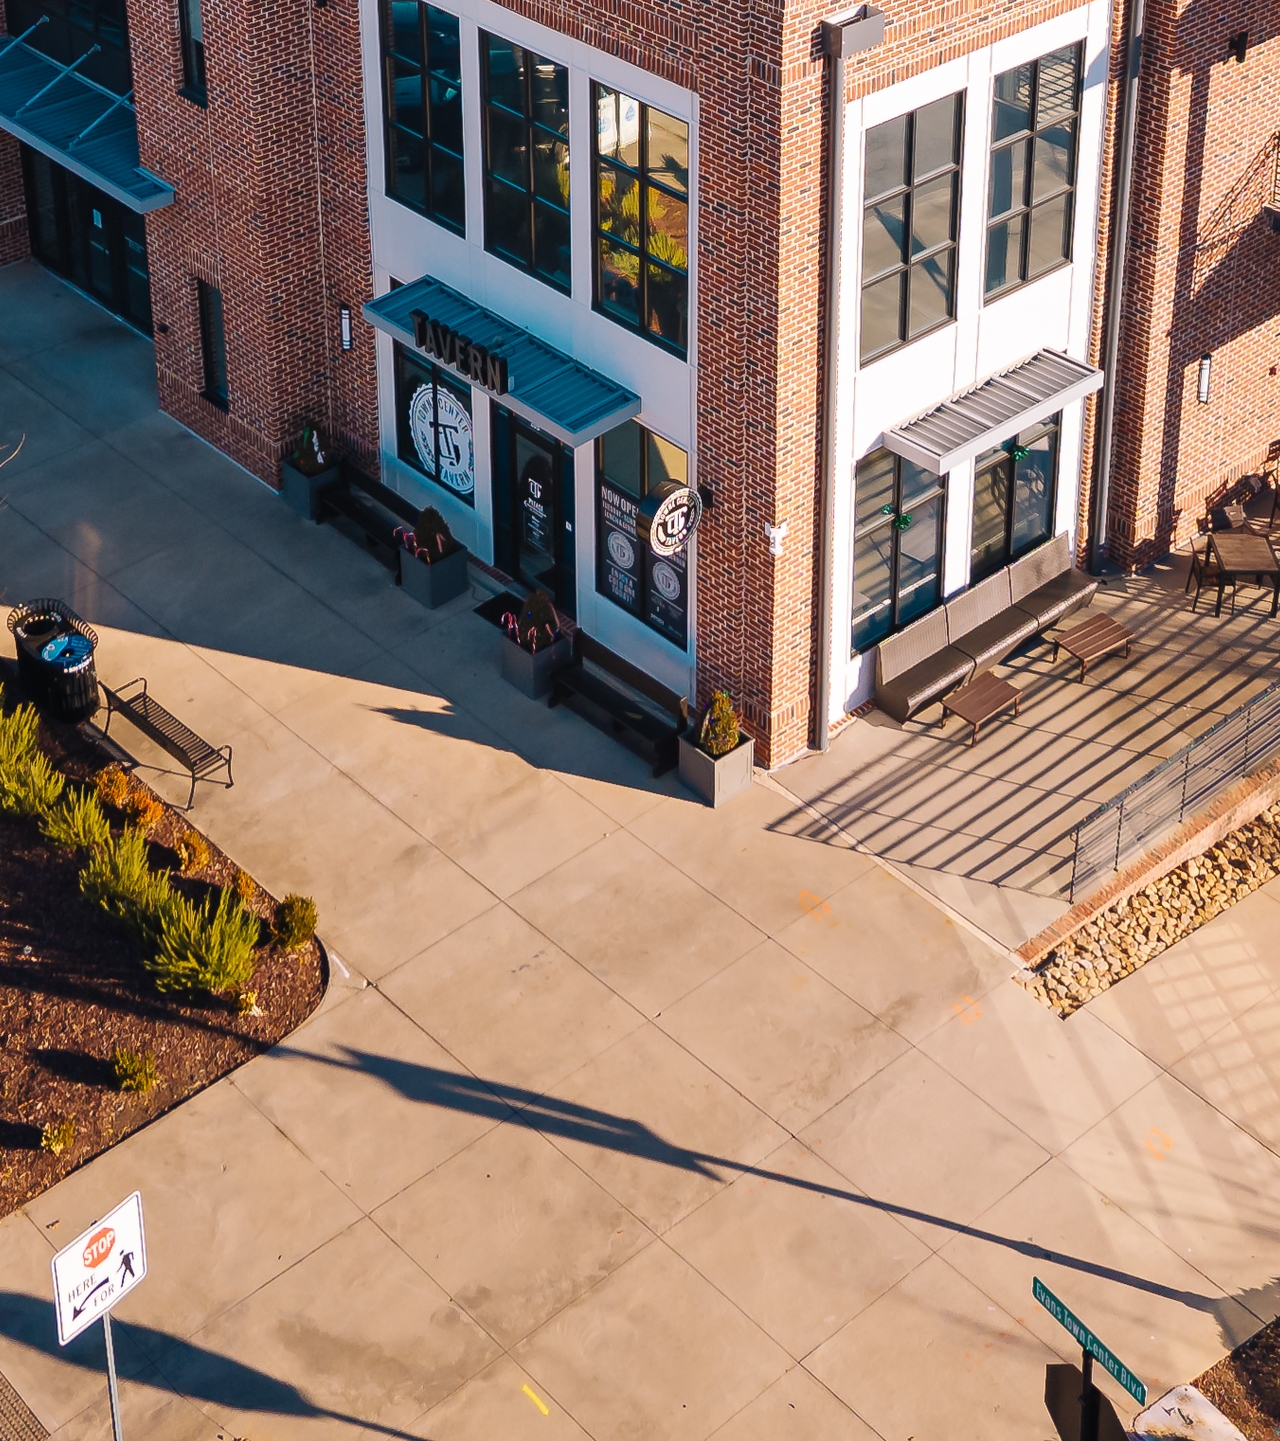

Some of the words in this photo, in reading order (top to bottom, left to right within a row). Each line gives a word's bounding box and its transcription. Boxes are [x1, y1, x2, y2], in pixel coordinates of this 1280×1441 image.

[410, 308, 508, 395] TAVERN
[437, 398, 469, 435] CENTER
[440, 464, 471, 487] TAVERN
[602, 485, 620, 507] NOW
[83, 1230, 115, 1266] STOP
[69, 1273, 96, 1303] HERE
[93, 1284, 115, 1307] FOR
[1036, 1282, 1061, 1320] Evans
[1063, 1308, 1085, 1344] Town
[1087, 1334, 1119, 1376] Center
[1120, 1368, 1142, 1400] Blvd
